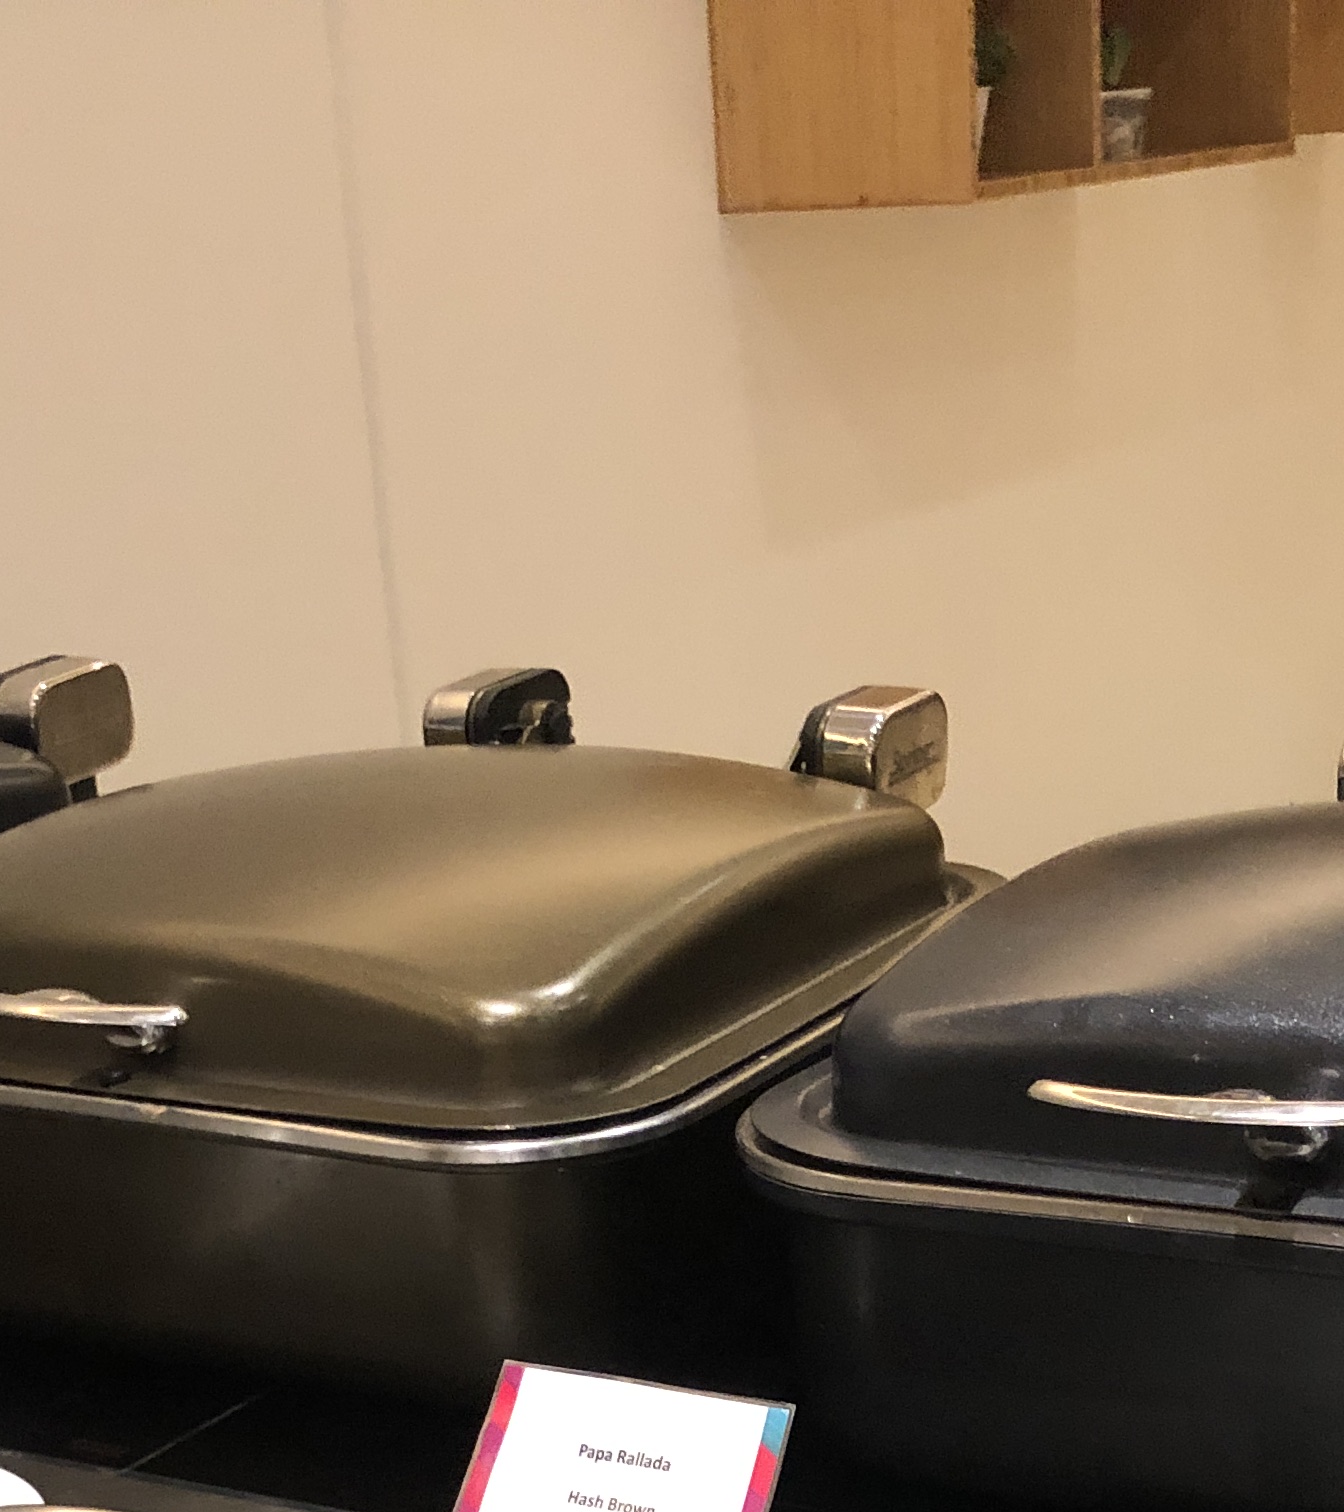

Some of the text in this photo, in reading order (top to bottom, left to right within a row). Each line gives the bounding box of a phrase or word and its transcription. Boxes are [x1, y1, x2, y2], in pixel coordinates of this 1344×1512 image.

[578, 1443, 672, 1472] Papa Rallada
[567, 1490, 604, 1509] Hash
